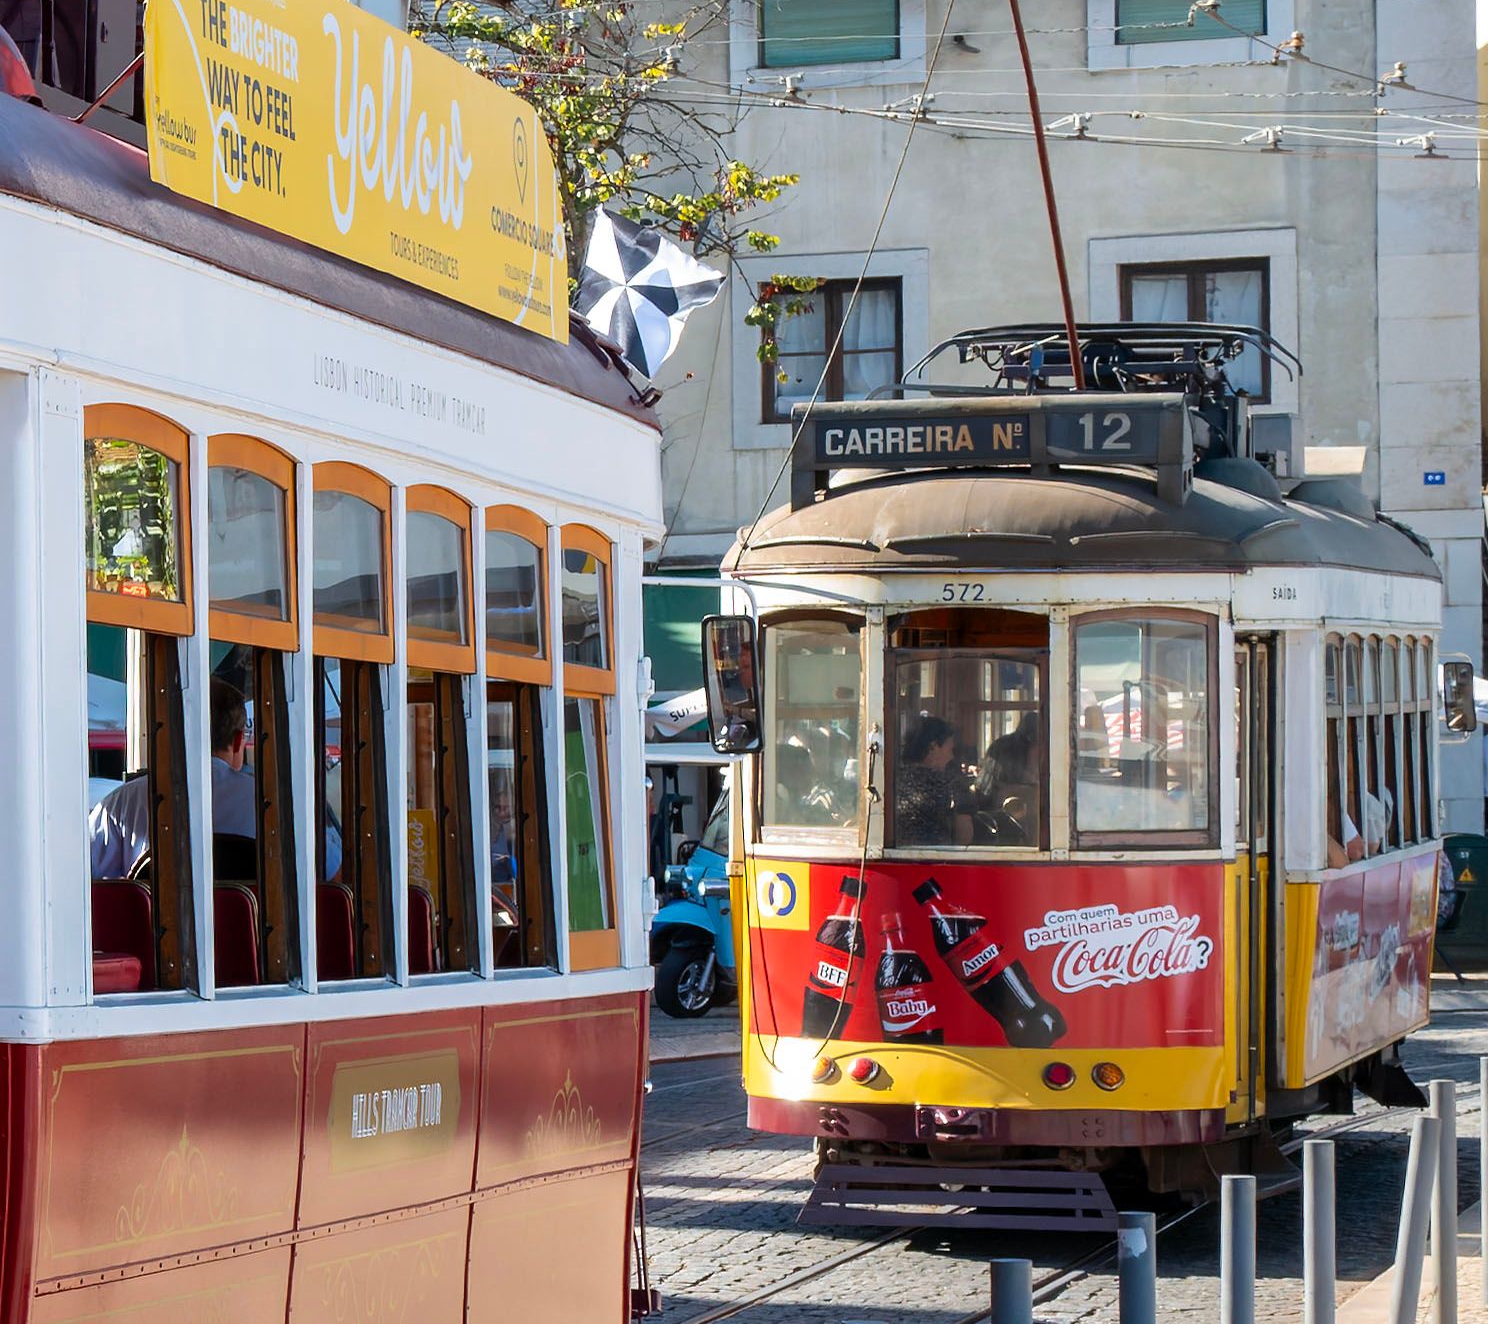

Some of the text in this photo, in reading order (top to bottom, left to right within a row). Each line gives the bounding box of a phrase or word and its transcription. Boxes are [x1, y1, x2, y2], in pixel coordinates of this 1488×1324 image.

[229, 5, 299, 83] BRIGHTER
[206, 57, 296, 141] WAY TO FEEL
[322, 12, 473, 235] Yellow
[220, 127, 248, 182] THE
[251, 139, 286, 198] CITY.
[389, 231, 412, 262] TOURS
[419, 243, 460, 280] EXPERIENCES
[313, 352, 486, 436] LISBON HISTORICAL PREMIUM TRAMCAR
[825, 424, 974, 456] CARREIRA
[1078, 412, 1132, 451] 12
[941, 583, 985, 603] 572
[1272, 583, 1298, 601] SAÍDA
[1028, 908, 1175, 946] partilharias uma
[1047, 907, 1115, 925] Com quem
[964, 944, 998, 974] Amor
[889, 999, 926, 1016] Baby
[351, 1082, 442, 1138] HILLS TRAMCAR TOUR
